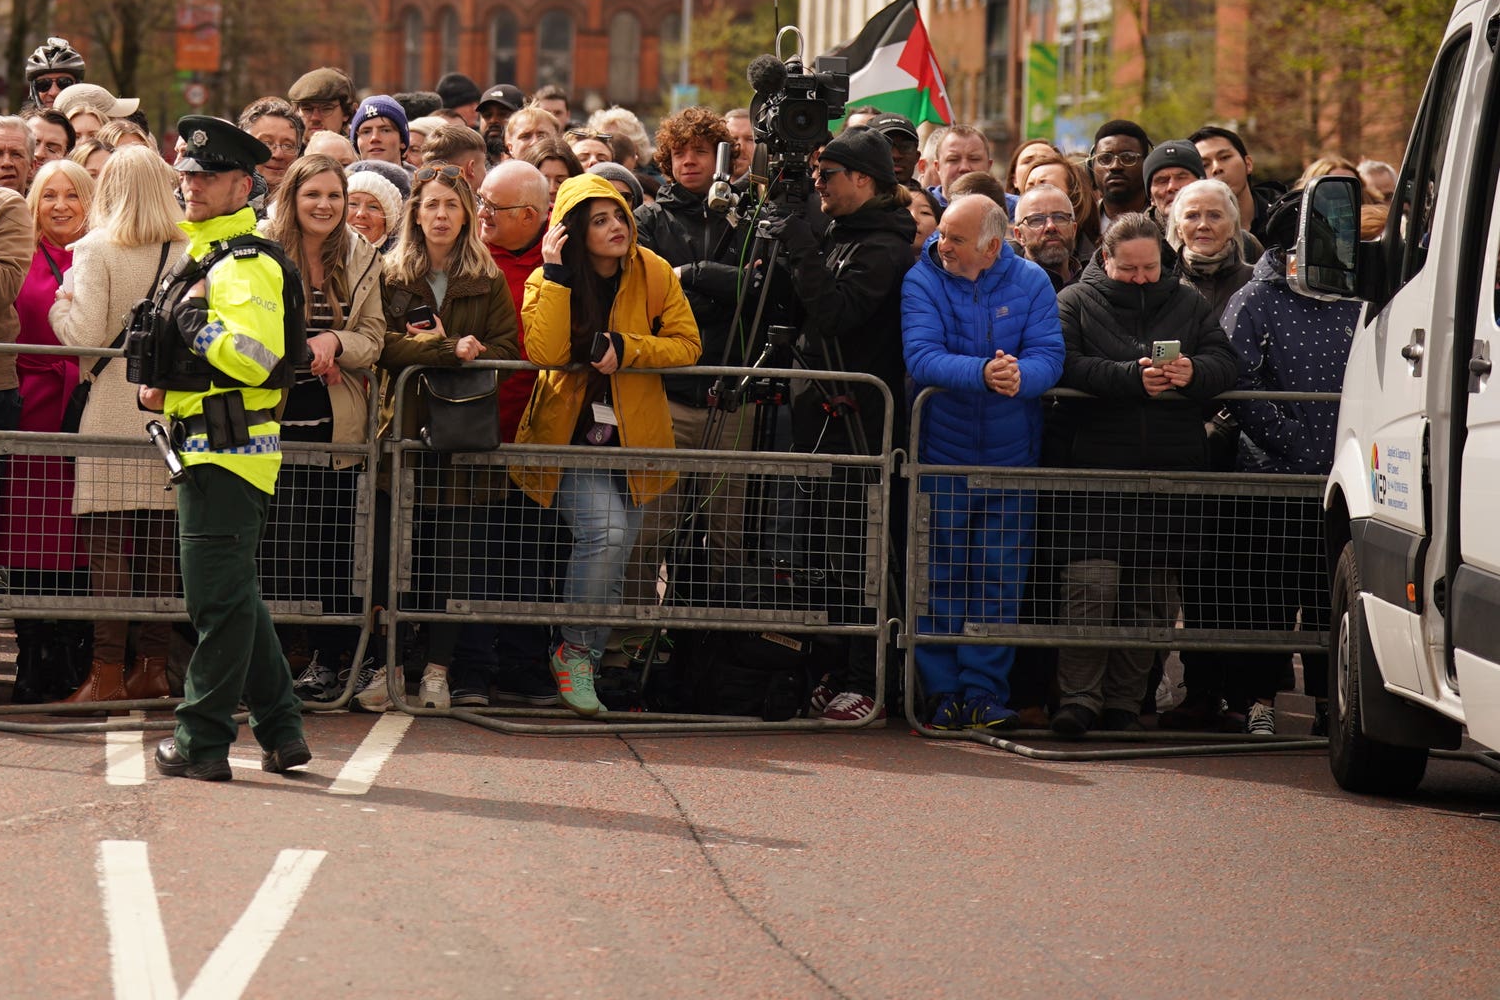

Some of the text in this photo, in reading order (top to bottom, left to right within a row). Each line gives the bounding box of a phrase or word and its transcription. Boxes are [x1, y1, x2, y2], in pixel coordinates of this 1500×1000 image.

[365, 104, 378, 117] LA
[251, 296, 277, 312] POLICE
[1375, 473, 1387, 505] NEP
